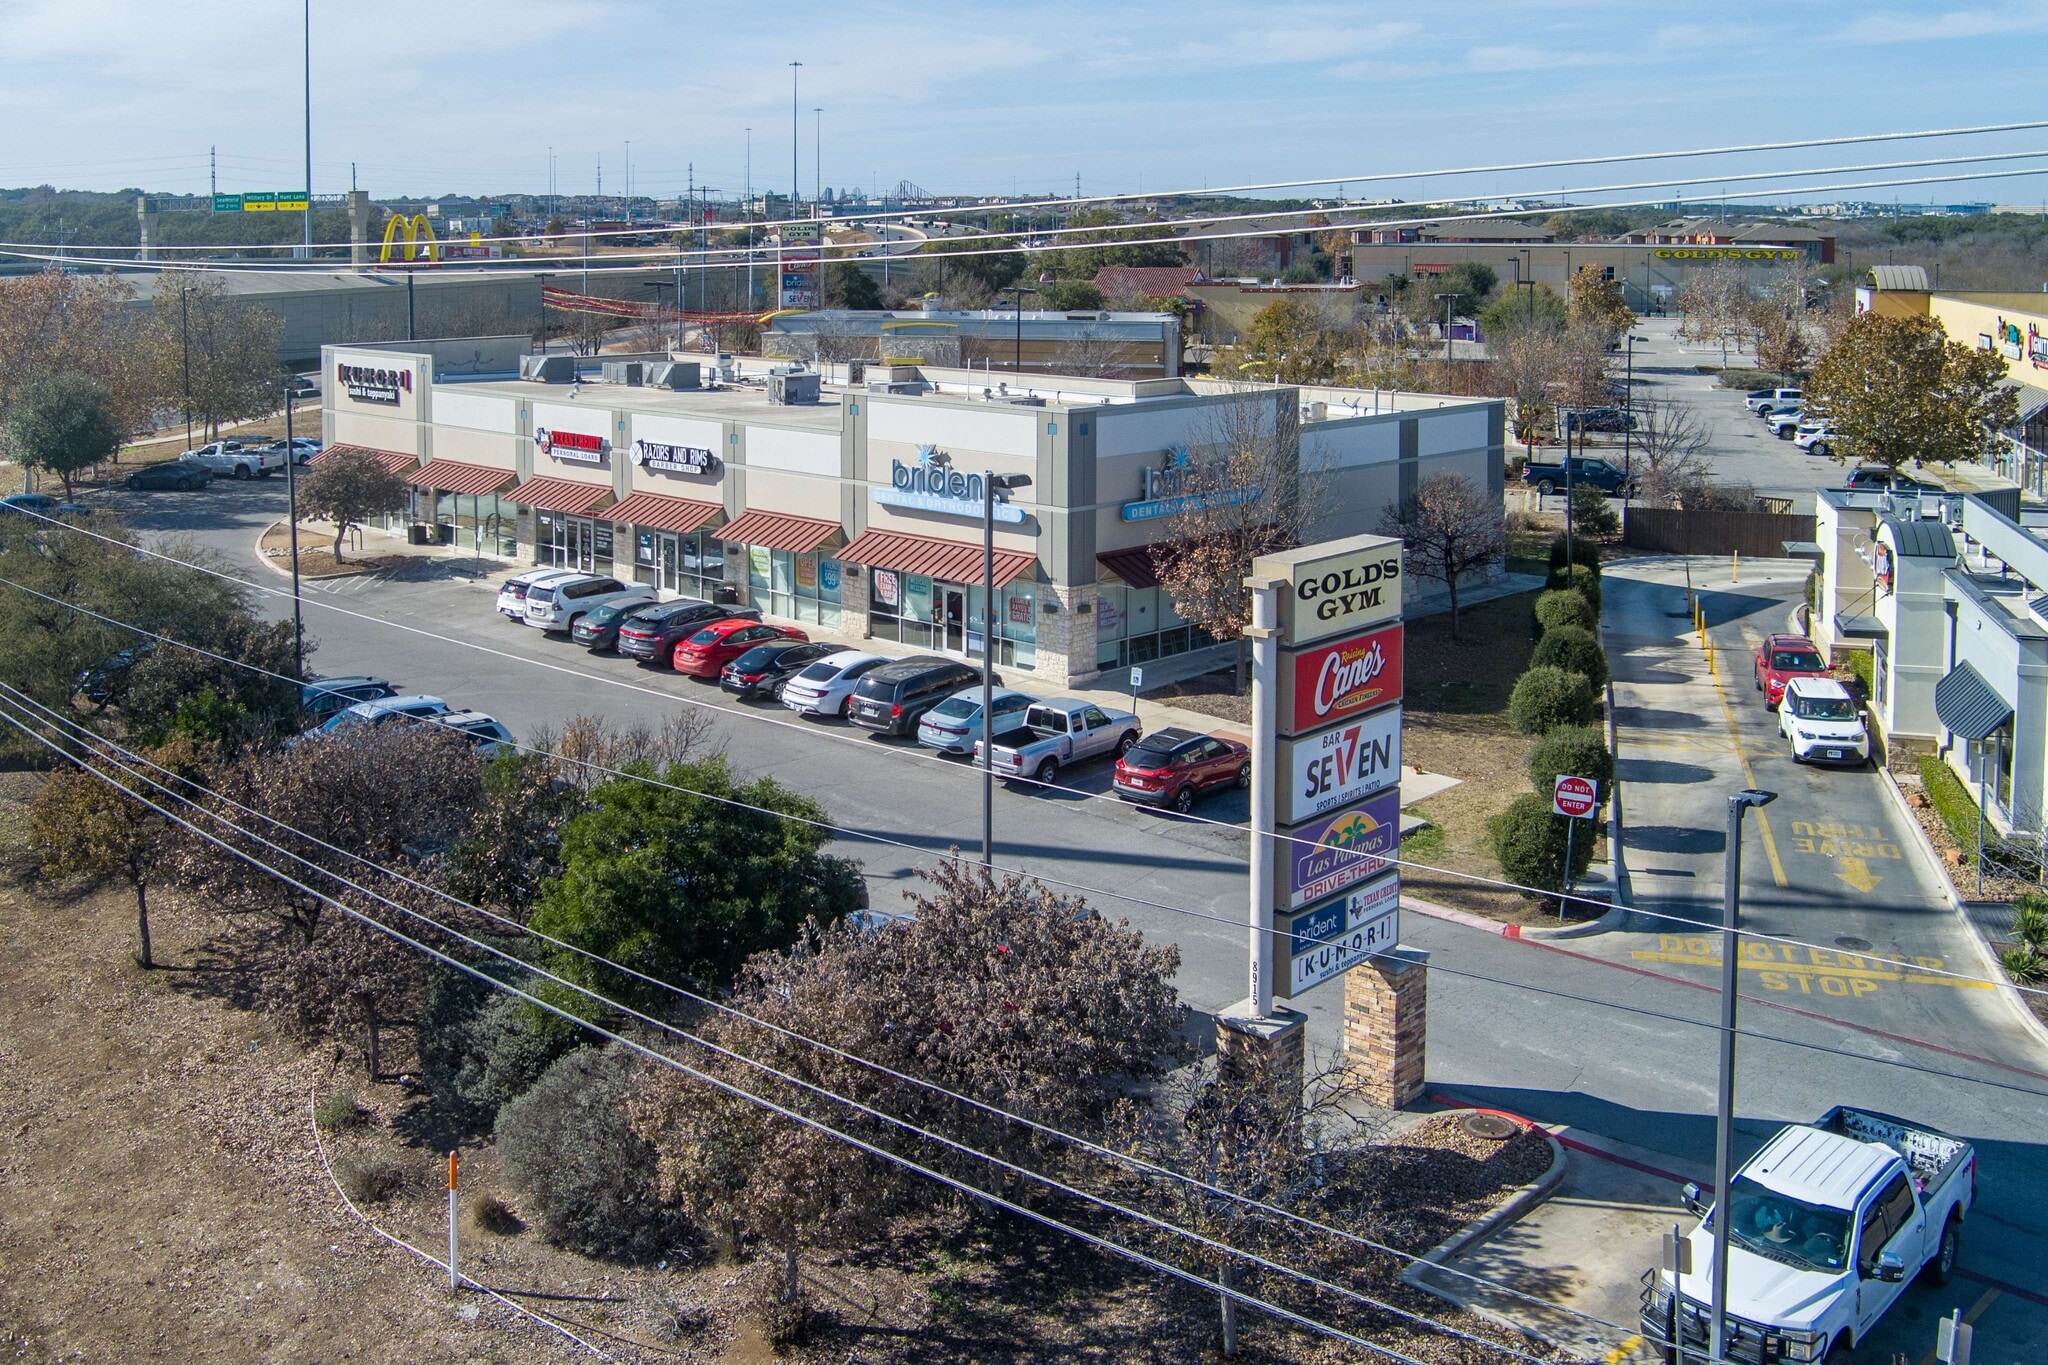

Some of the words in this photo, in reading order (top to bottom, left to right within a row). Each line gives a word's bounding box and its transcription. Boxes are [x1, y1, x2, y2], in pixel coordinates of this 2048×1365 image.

[1654, 249, 1742, 259] GOLD'S
[349, 387, 361, 396] sushi
[362, 388, 366, 396] &
[553, 449, 579, 458] PERSONAL
[581, 453, 598, 461] LOANS
[644, 444, 669, 461] RAZORS
[672, 448, 686, 463] AND
[690, 450, 708, 466] RIMS
[652, 461, 678, 470] BARBER
[892, 459, 983, 499] briden
[874, 491, 913, 505] DENTAL
[926, 498, 1016, 518] ORTHODOTICS
[880, 572, 897, 585] FREE
[1298, 558, 1399, 600] GOLD'S
[1317, 587, 1382, 620] GYM
[1342, 648, 1365, 664] Raising
[1315, 640, 1385, 716] Cane's
[1339, 697, 1360, 707] CHICKEN
[1360, 690, 1378, 701] FINGERS
[1322, 732, 1340, 749] BAR
[1316, 796, 1337, 811] SPORTS
[1341, 787, 1361, 802] SPIRITS
[1364, 780, 1380, 792] PATIO
[1562, 801, 1585, 810] ENTER
[1307, 857, 1330, 877] Las
[1333, 835, 1383, 866] Palapas
[1304, 855, 1386, 901] DRIVE-THRU
[1364, 890, 1379, 906] TEXAN
[1380, 882, 1398, 898] CREDIT
[1300, 915, 1337, 943] brident
[1659, 934, 1711, 955] DO
[1810, 946, 1944, 975] ENTER
[1320, 966, 1334, 978] sushi
[1760, 971, 1879, 997] STOP
